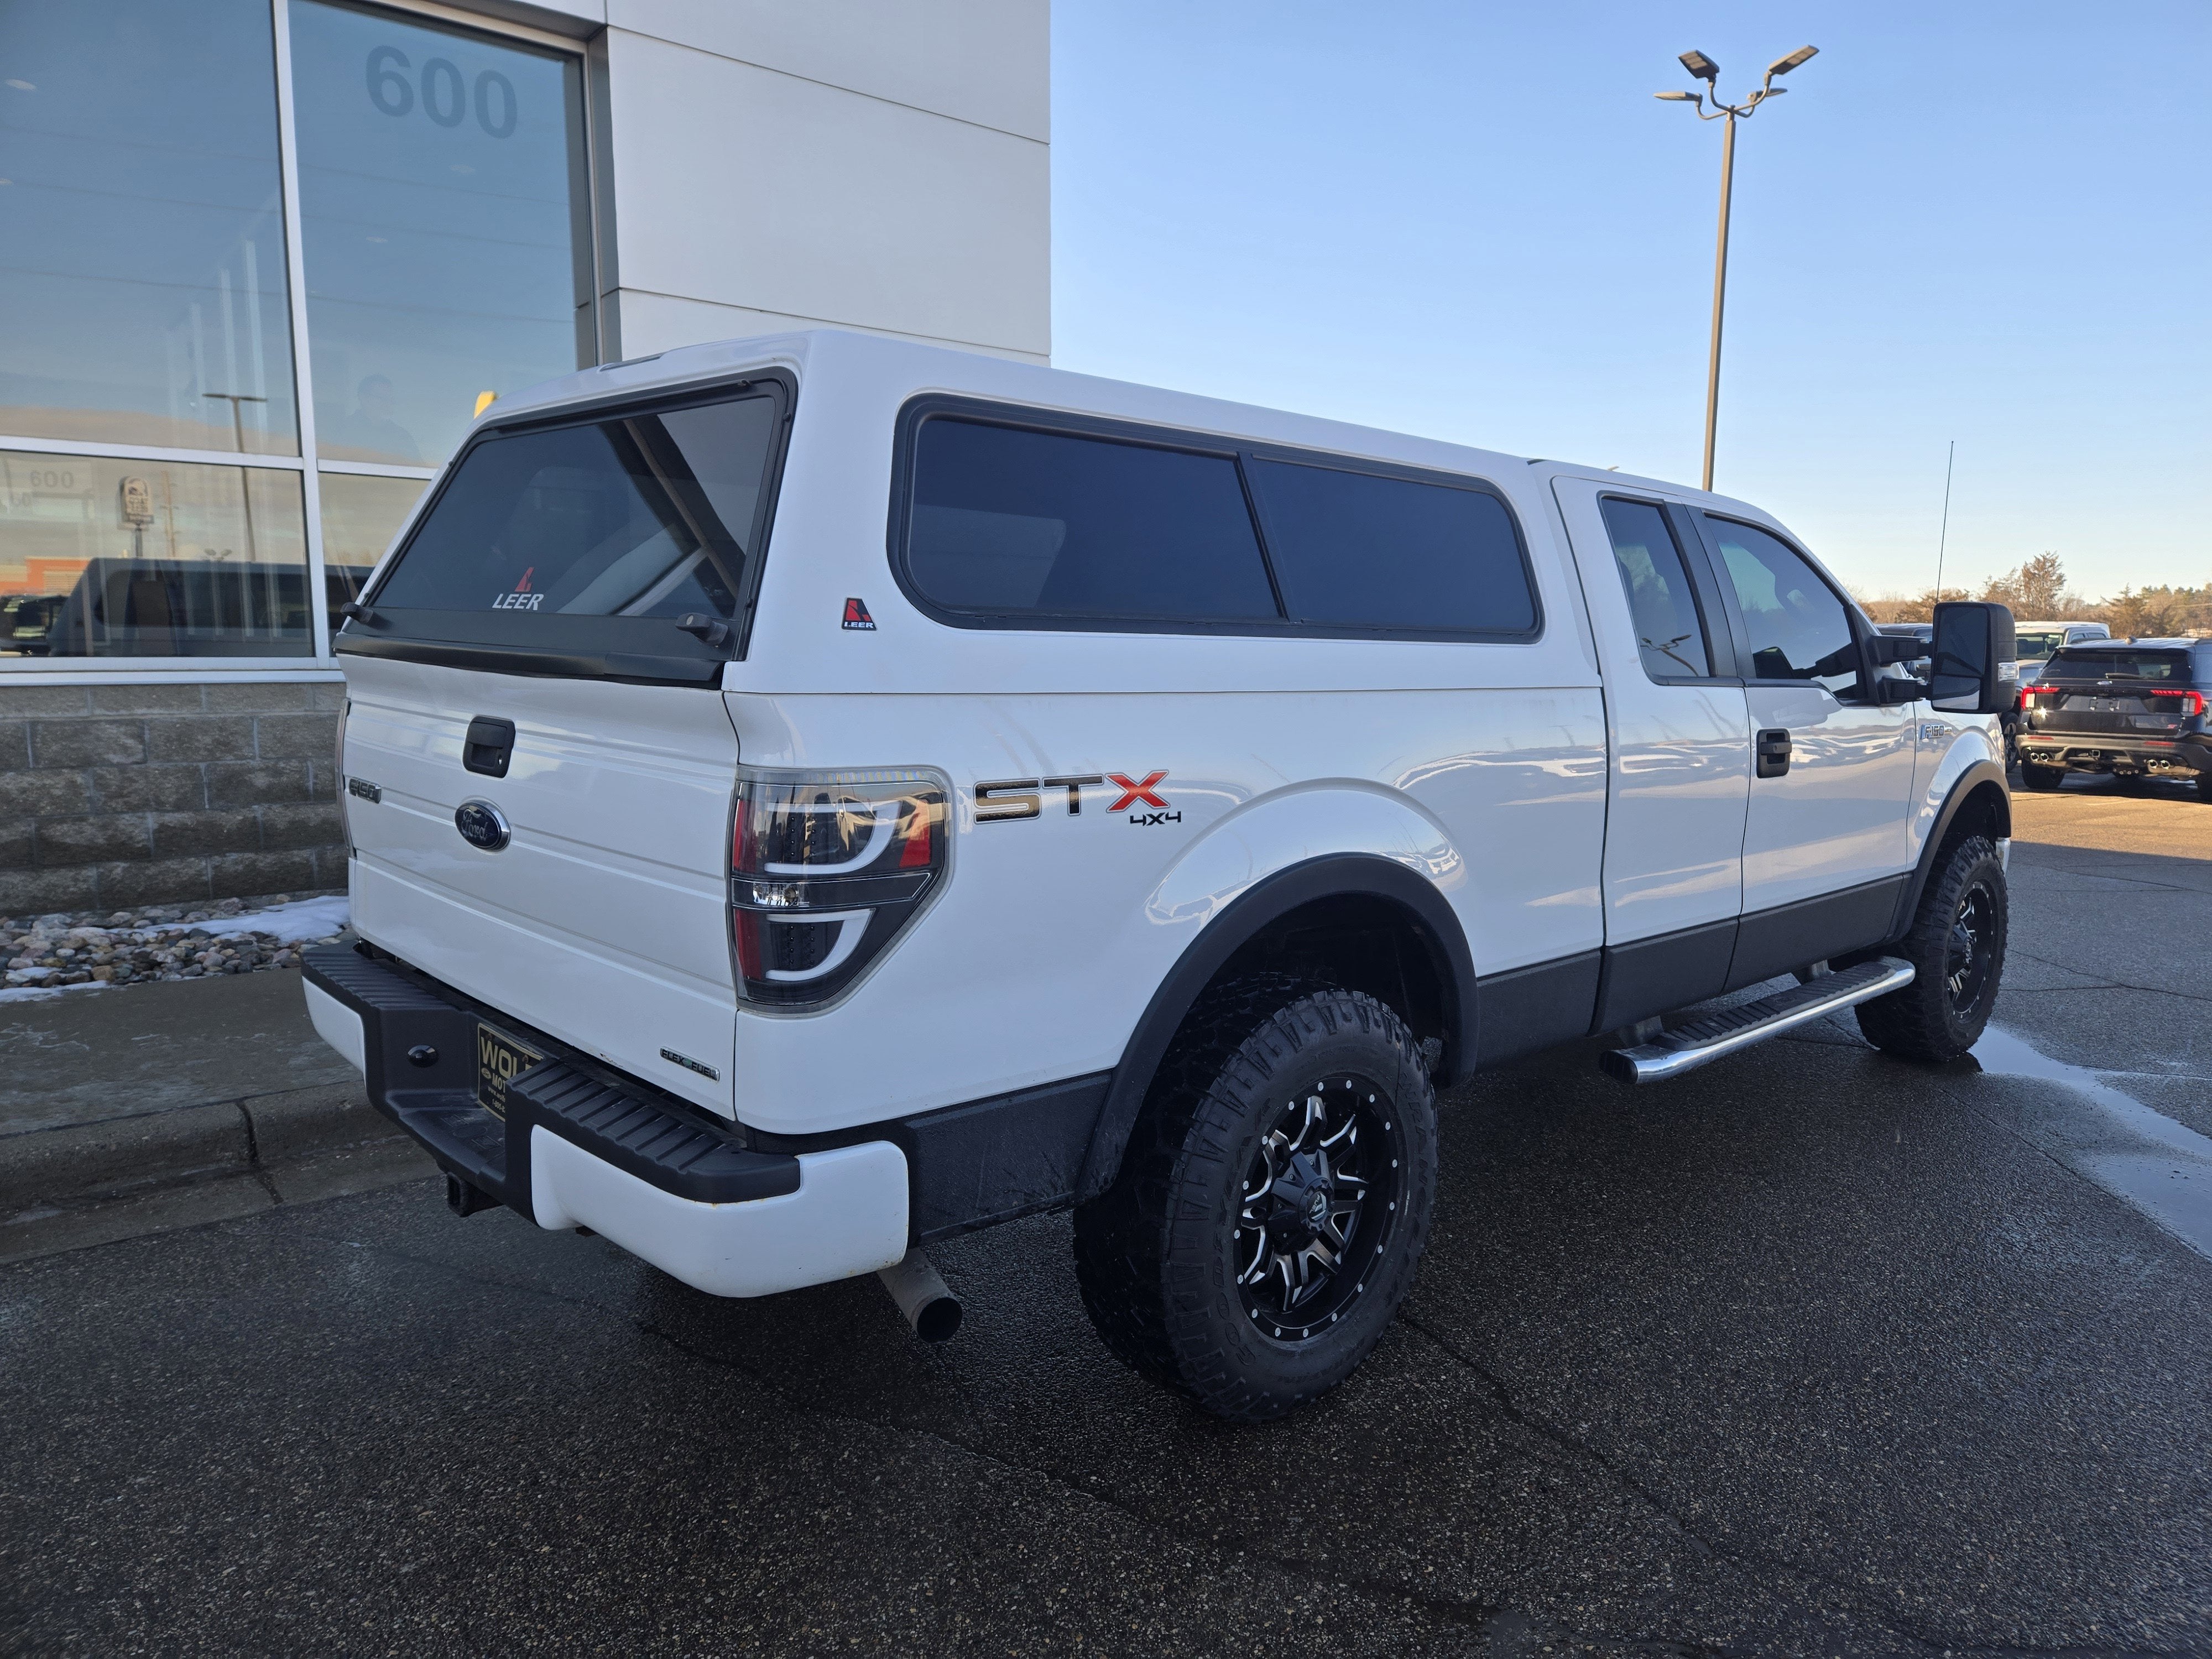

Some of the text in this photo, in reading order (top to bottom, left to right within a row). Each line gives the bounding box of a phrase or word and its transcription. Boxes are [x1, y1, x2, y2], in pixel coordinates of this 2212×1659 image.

[366, 45, 518, 139] 600
[30, 471, 74, 489] 600
[492, 593, 544, 611] LEER
[973, 770, 1171, 825] STX
[461, 808, 488, 841] Ford
[662, 1048, 718, 1081] FLEX FUEL
[1214, 1097, 1271, 1366] GOODYEAR
